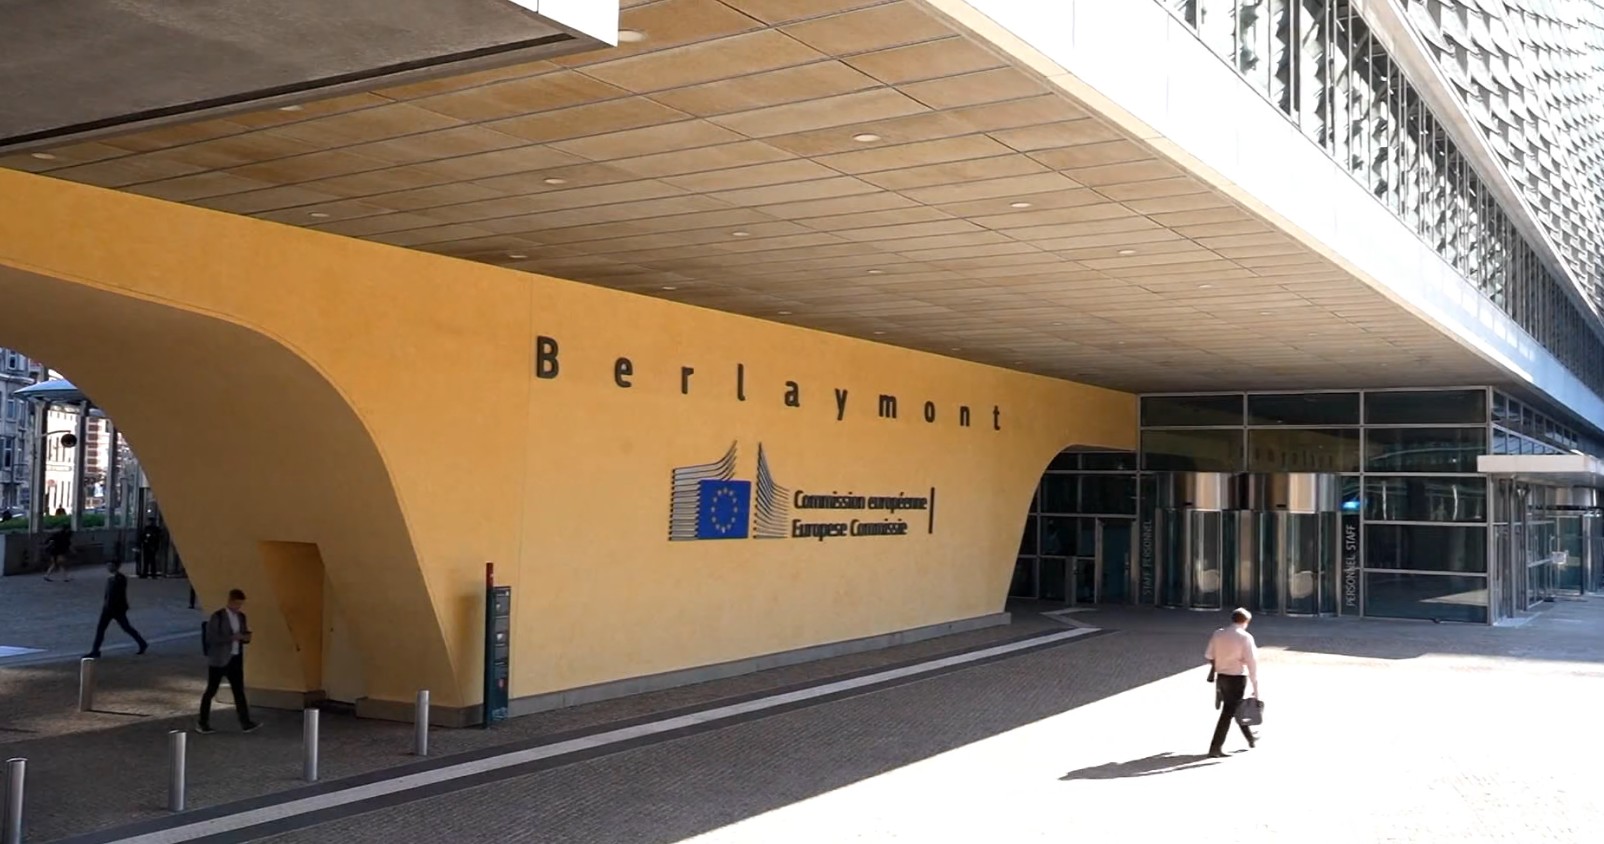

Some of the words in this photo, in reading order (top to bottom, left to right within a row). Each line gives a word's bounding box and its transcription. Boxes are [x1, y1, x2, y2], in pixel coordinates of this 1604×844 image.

[536, 335, 1001, 431] Berlaymont
[794, 490, 865, 509] Commission
[867, 491, 928, 514] européenne
[792, 519, 848, 541] Europese
[850, 519, 908, 536] Commissie
[1345, 524, 1357, 551] STAFF
[1345, 555, 1357, 607] PERSONNEL
